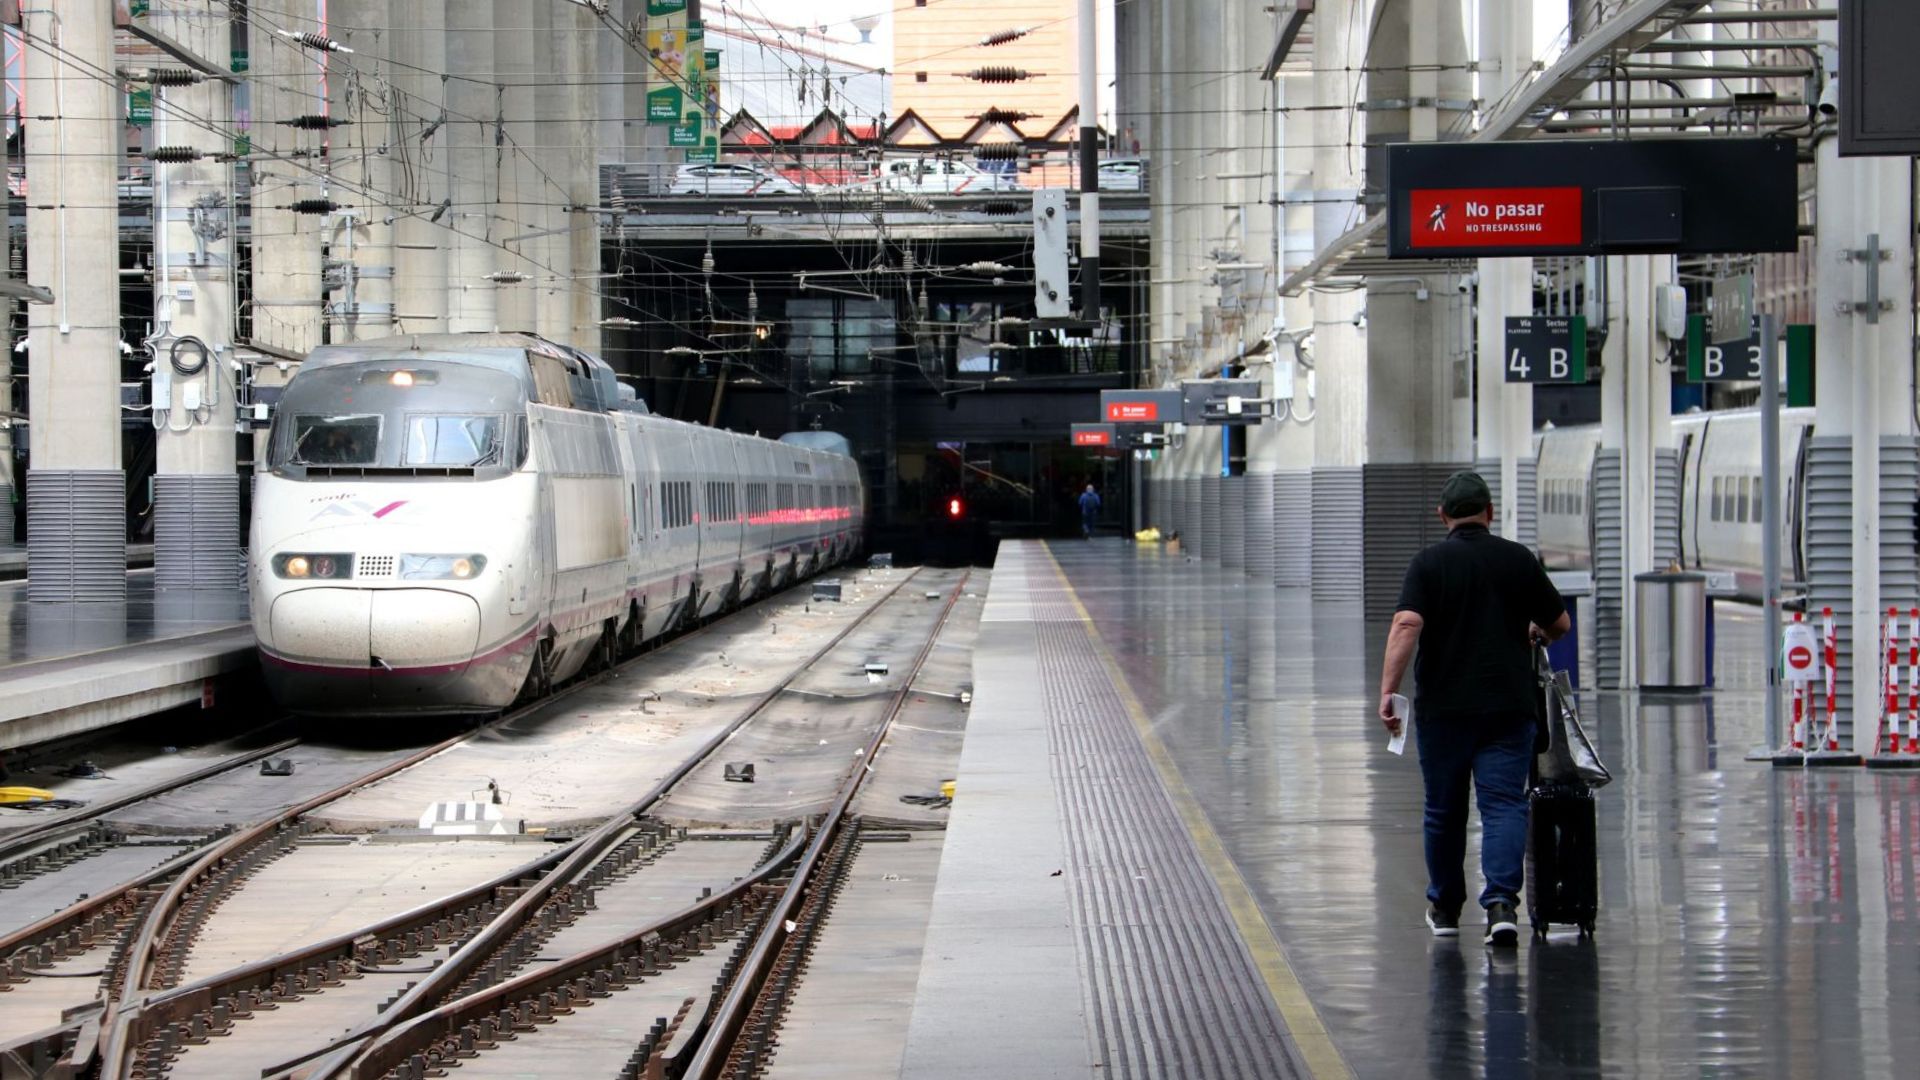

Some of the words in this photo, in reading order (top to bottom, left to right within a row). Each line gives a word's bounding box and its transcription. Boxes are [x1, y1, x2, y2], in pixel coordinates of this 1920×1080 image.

[1466, 202, 1489, 217] No
[1496, 203, 1545, 220] pasar
[1481, 223, 1542, 232] TRESPASSING
[1509, 348, 1531, 378] 4
[1550, 347, 1569, 378] B
[1705, 346, 1724, 377] B
[1747, 346, 1761, 377] 3
[310, 493, 357, 503] renfe
